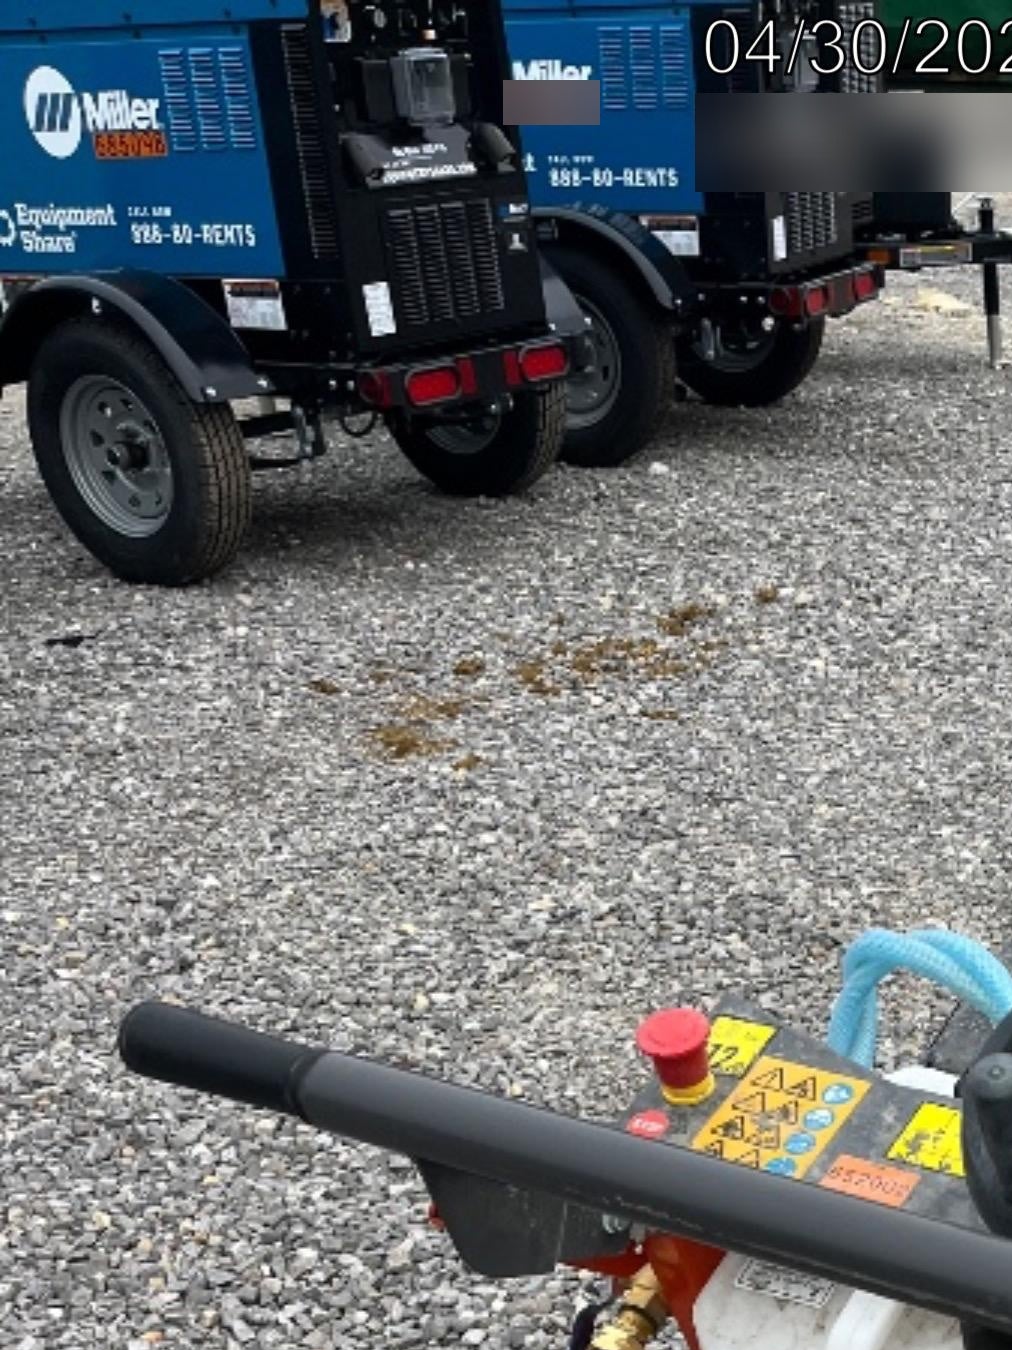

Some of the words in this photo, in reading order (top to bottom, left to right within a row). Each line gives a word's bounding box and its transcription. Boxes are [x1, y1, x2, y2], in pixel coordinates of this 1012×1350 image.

[83, 90, 161, 132] Miller
[14, 202, 117, 230] Equipment
[20, 229, 77, 253] Share
